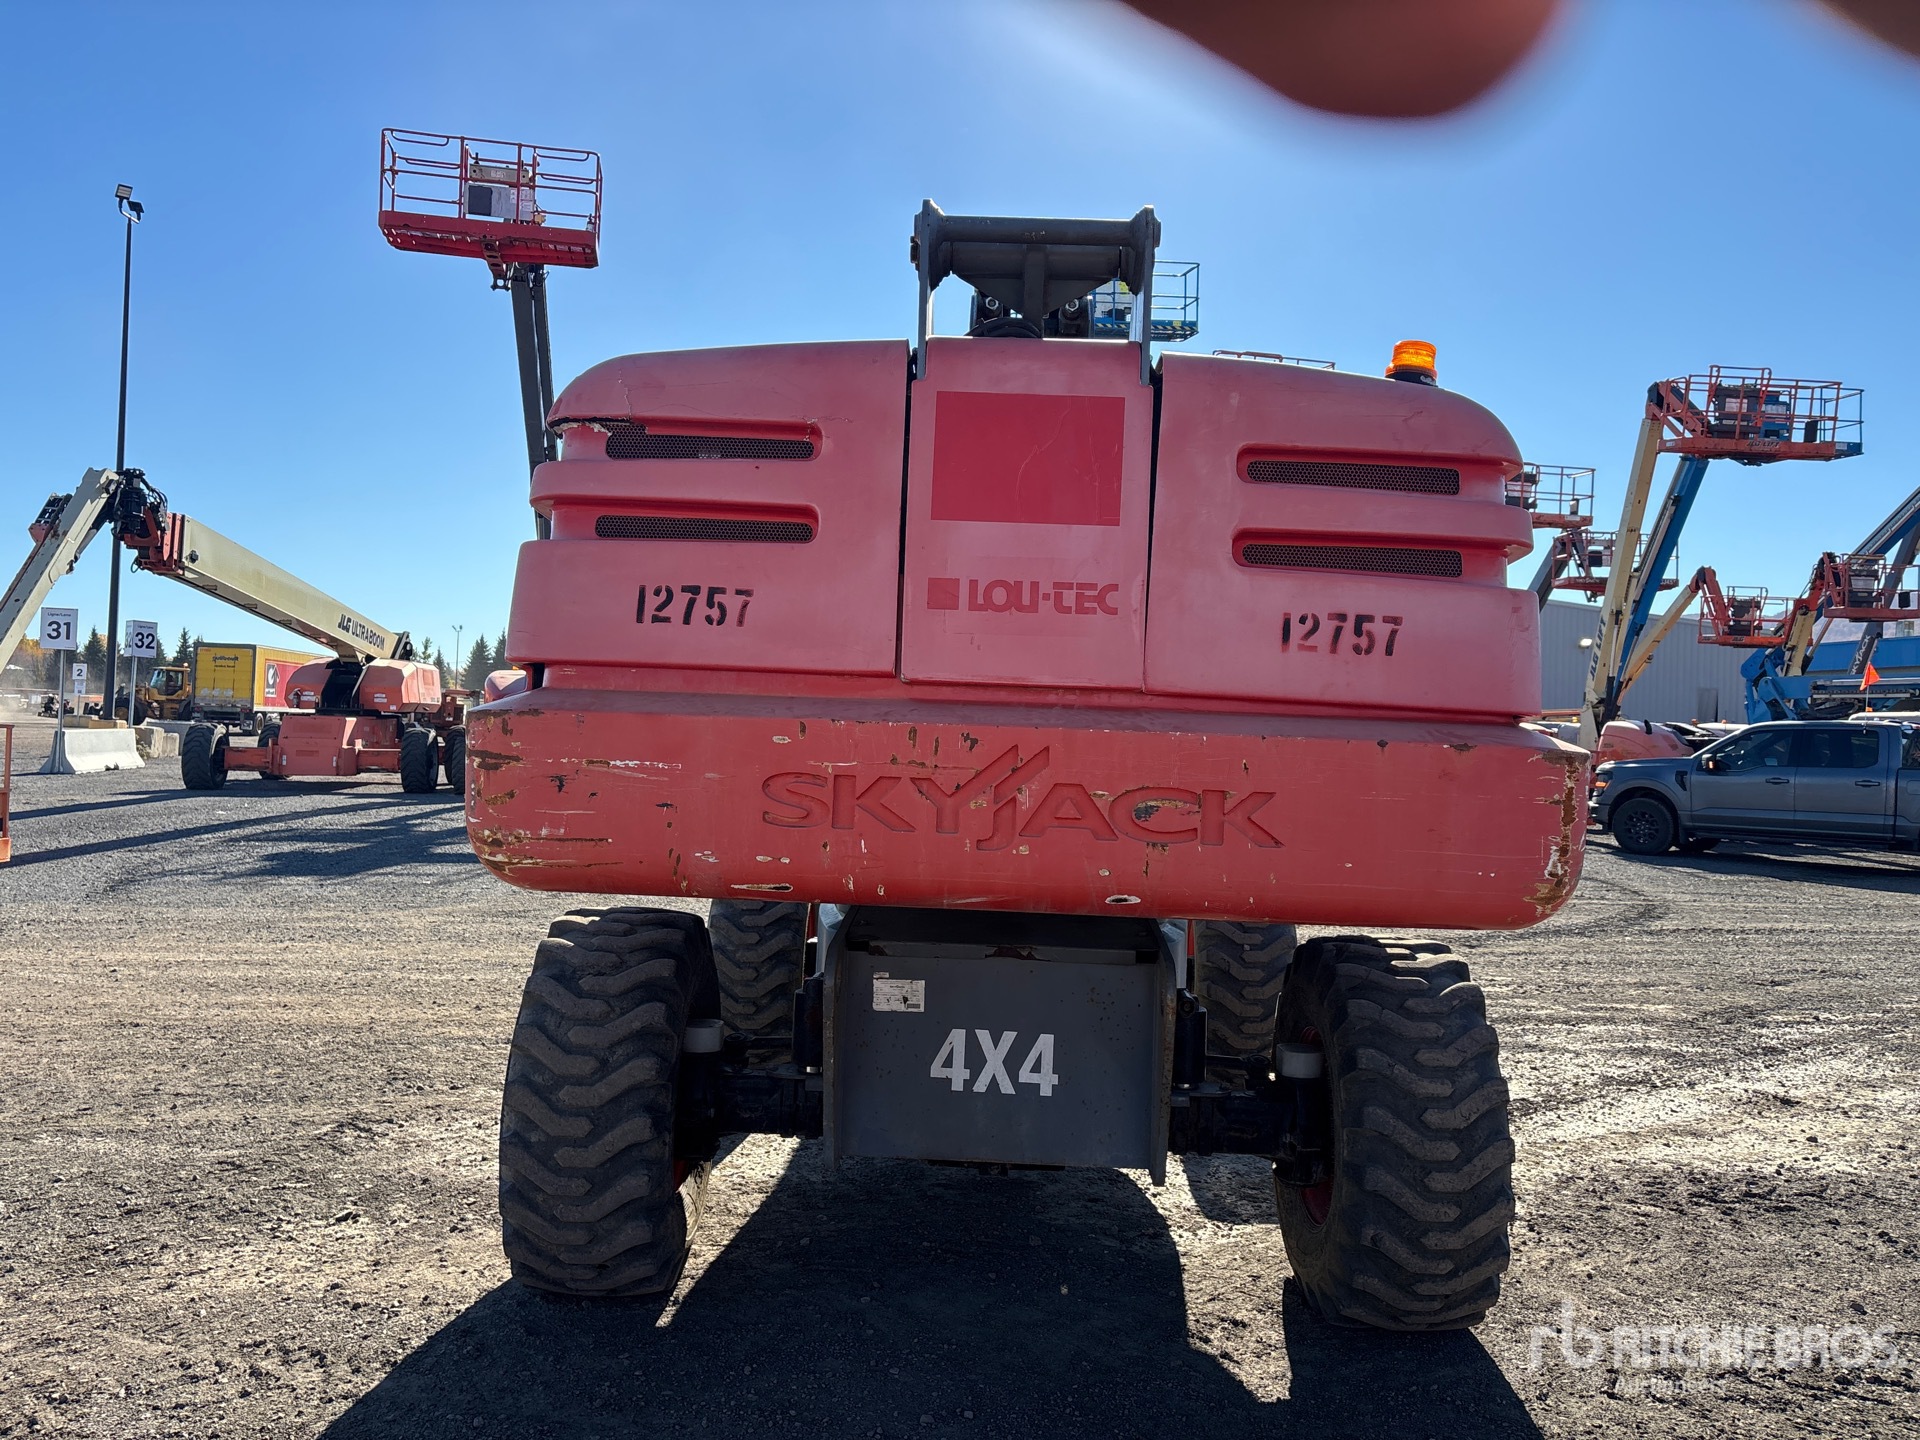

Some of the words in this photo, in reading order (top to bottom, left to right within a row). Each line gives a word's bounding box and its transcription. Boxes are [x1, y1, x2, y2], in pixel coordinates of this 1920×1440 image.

[636, 584, 754, 627] 12757
[968, 579, 1120, 616] LOU-TEC
[47, 620, 71, 640] 31
[135, 632, 155, 649] 32
[338, 613, 352, 633] JLG
[351, 619, 386, 651] ULTRABOOM
[1281, 612, 1403, 656] 12757
[1590, 651, 1599, 681] JLG
[1596, 615, 1606, 651] LIFT
[76, 668, 83, 677] 2
[761, 744, 1285, 852] SKYJACK
[929, 1028, 1059, 1097] 4X4
